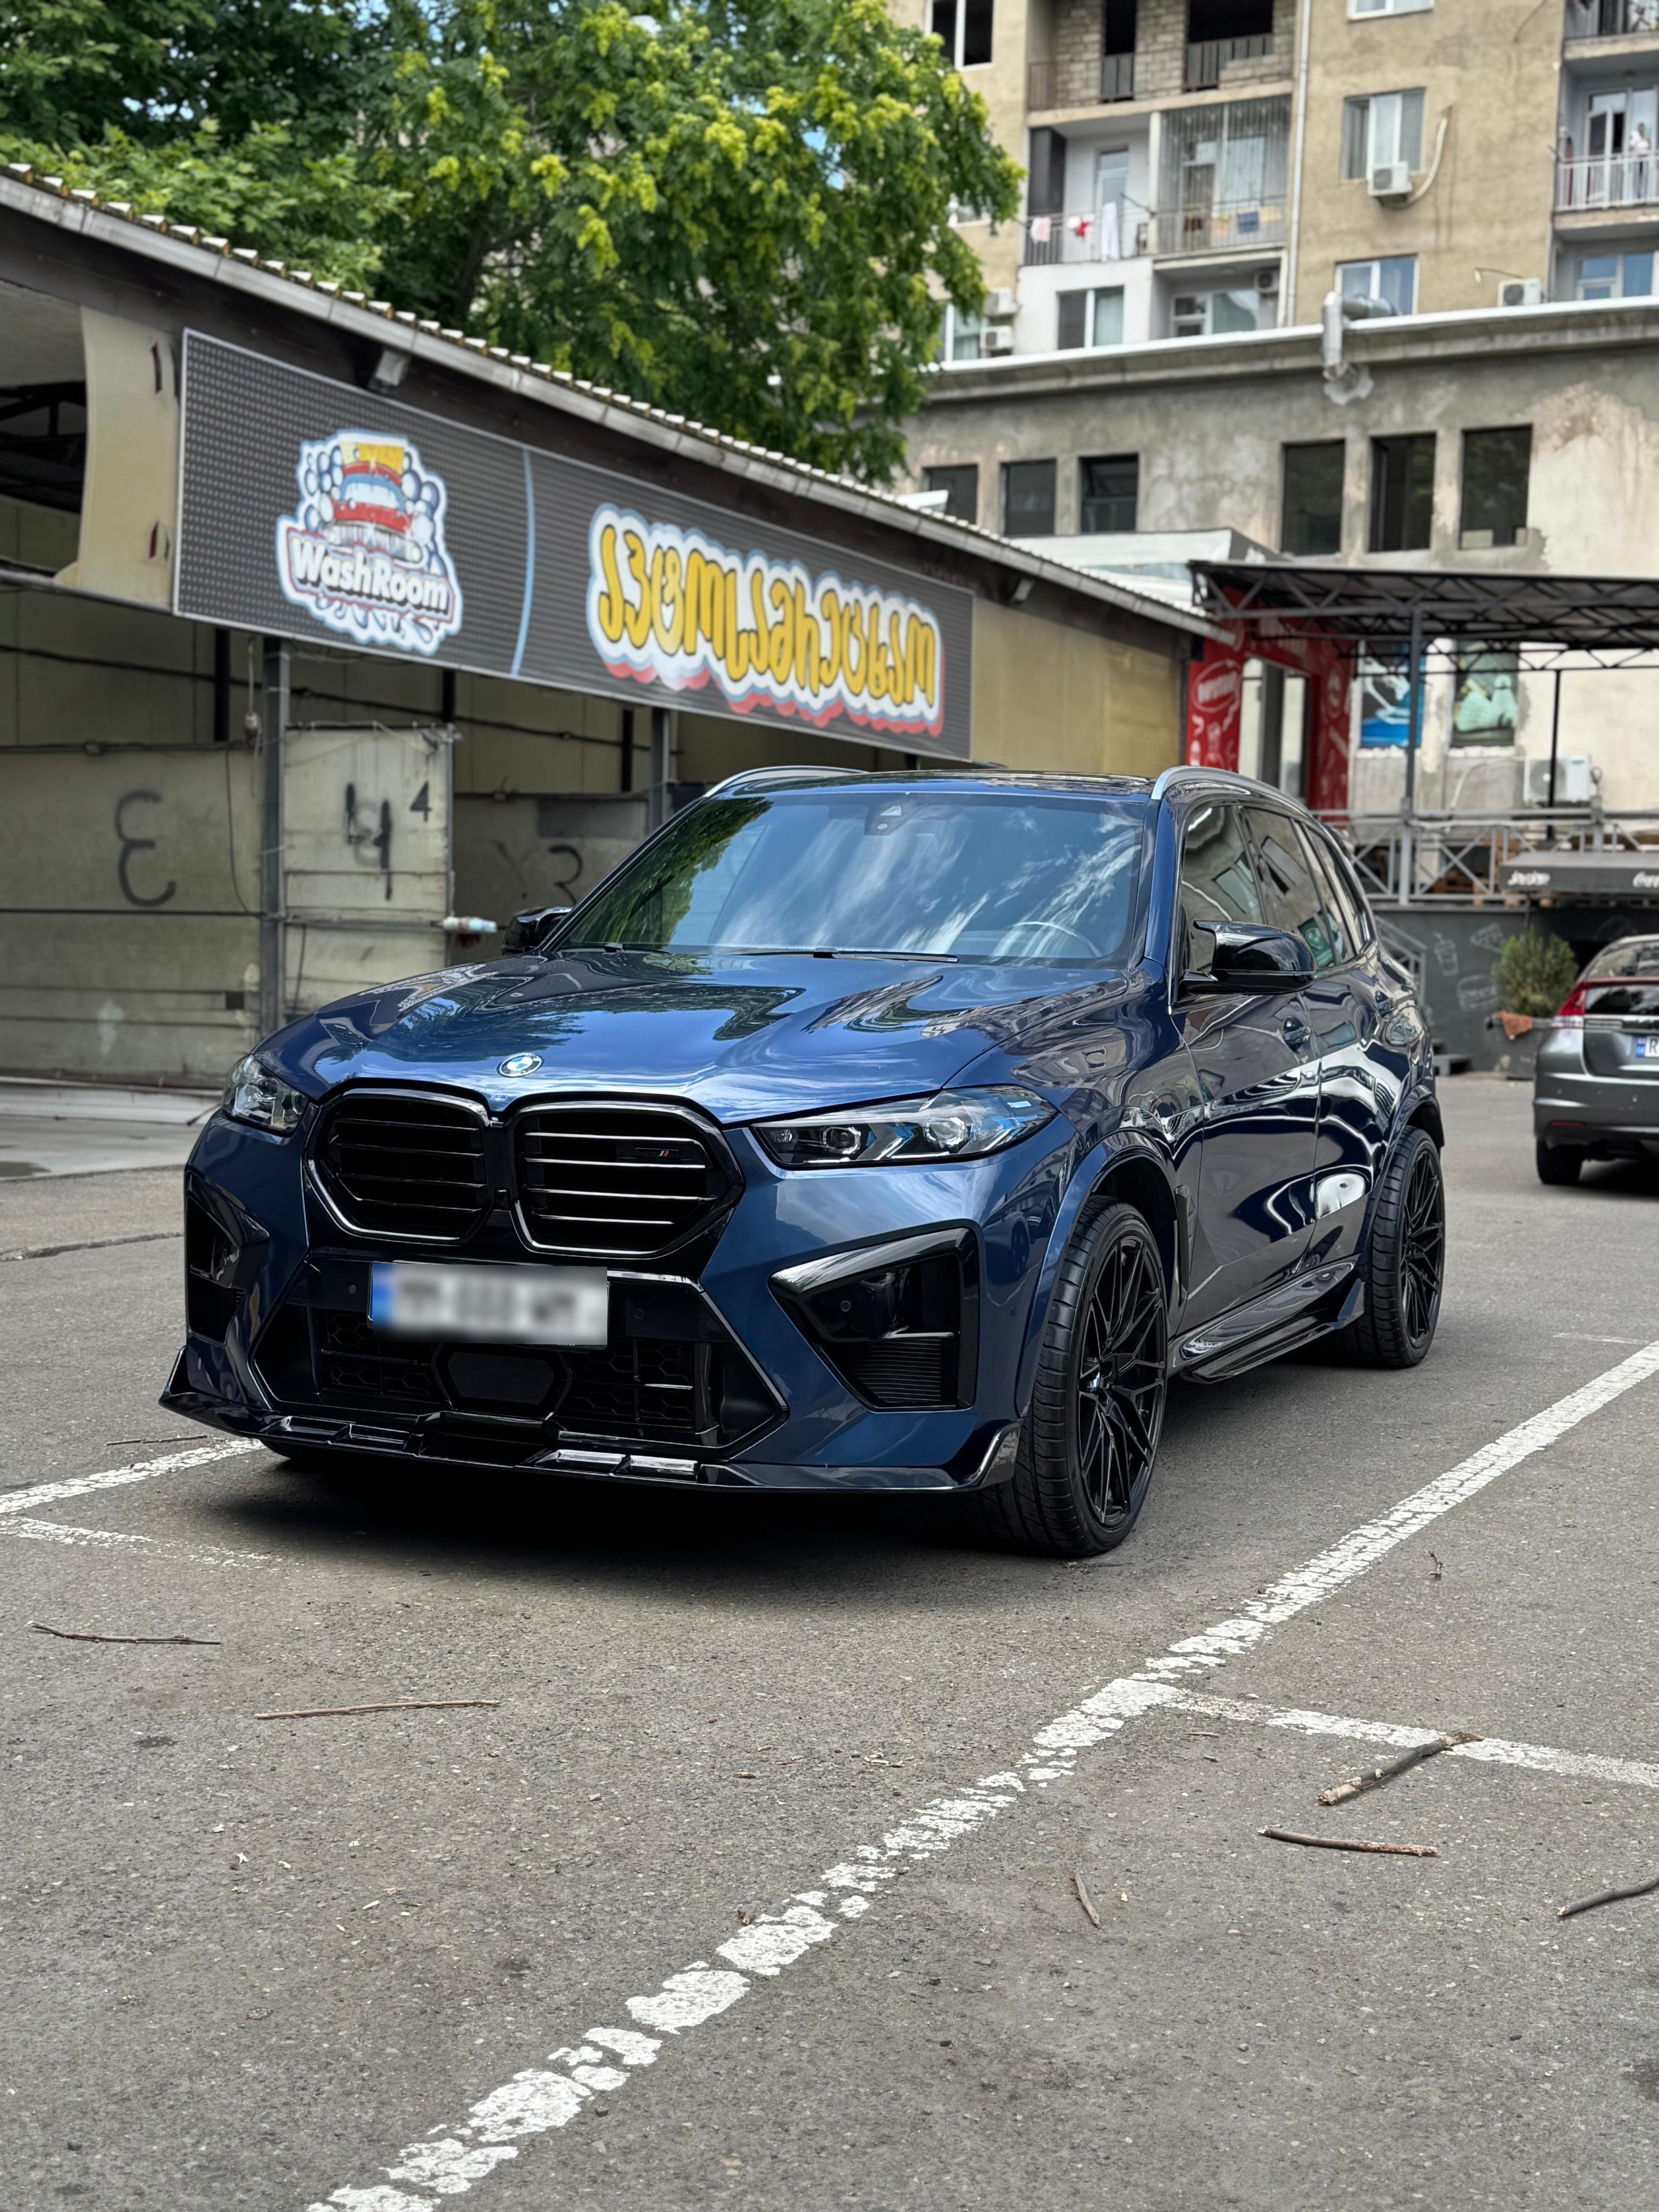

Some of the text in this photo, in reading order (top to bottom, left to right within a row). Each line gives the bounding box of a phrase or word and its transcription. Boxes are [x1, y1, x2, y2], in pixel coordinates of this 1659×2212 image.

[292, 537, 449, 616] WashRoom
[598, 524, 935, 707] ავტოსამრეცხაო
[409, 780, 432, 823] 4
